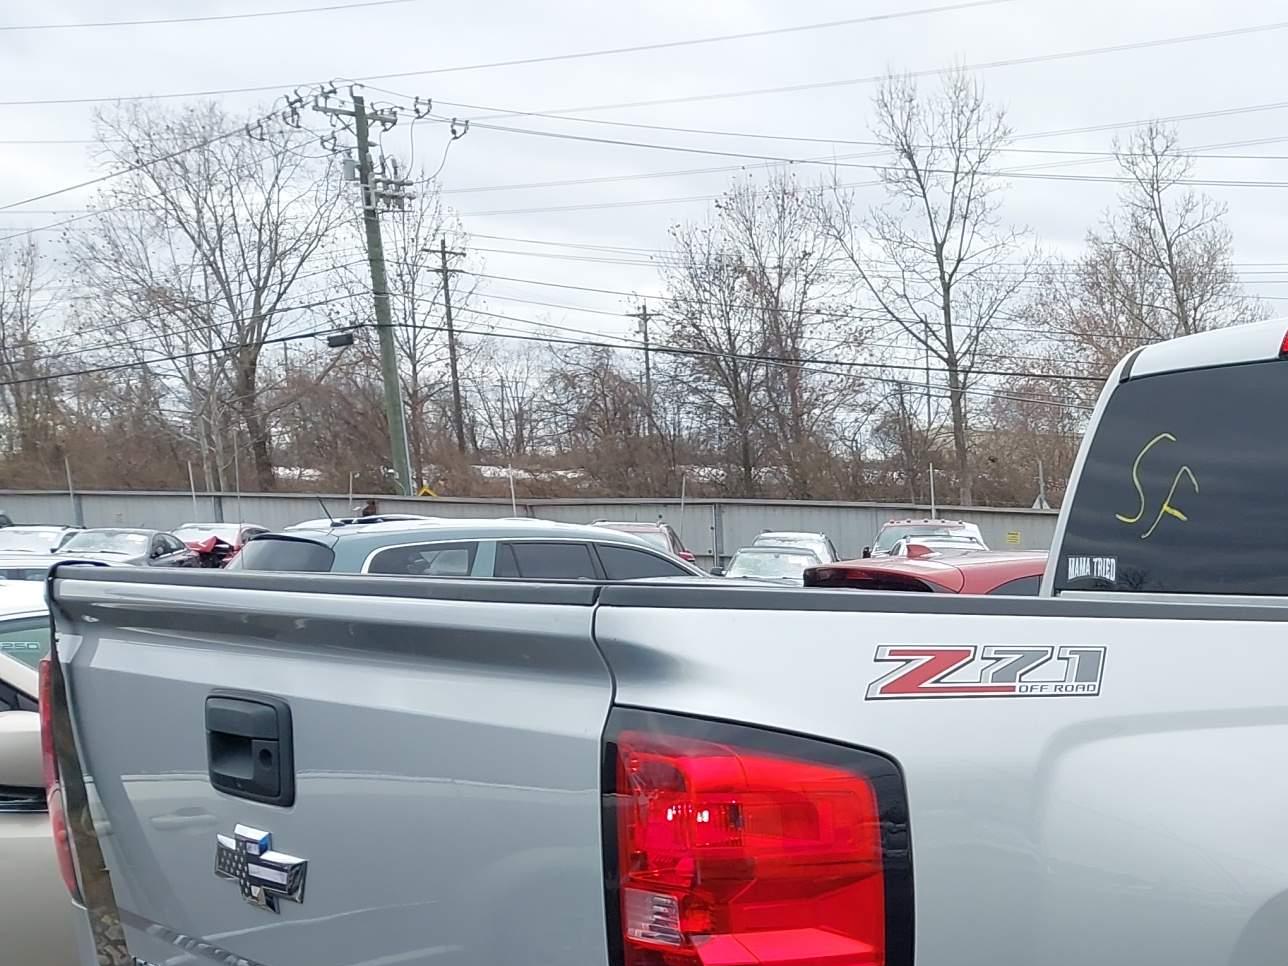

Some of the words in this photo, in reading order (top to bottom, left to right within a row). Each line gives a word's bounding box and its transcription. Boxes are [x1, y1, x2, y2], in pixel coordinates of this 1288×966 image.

[1092, 557, 1116, 582] TRIED
[864, 644, 1107, 700] Z71
[1018, 684, 1049, 694] OFF
[1053, 683, 1098, 693] ROAD
